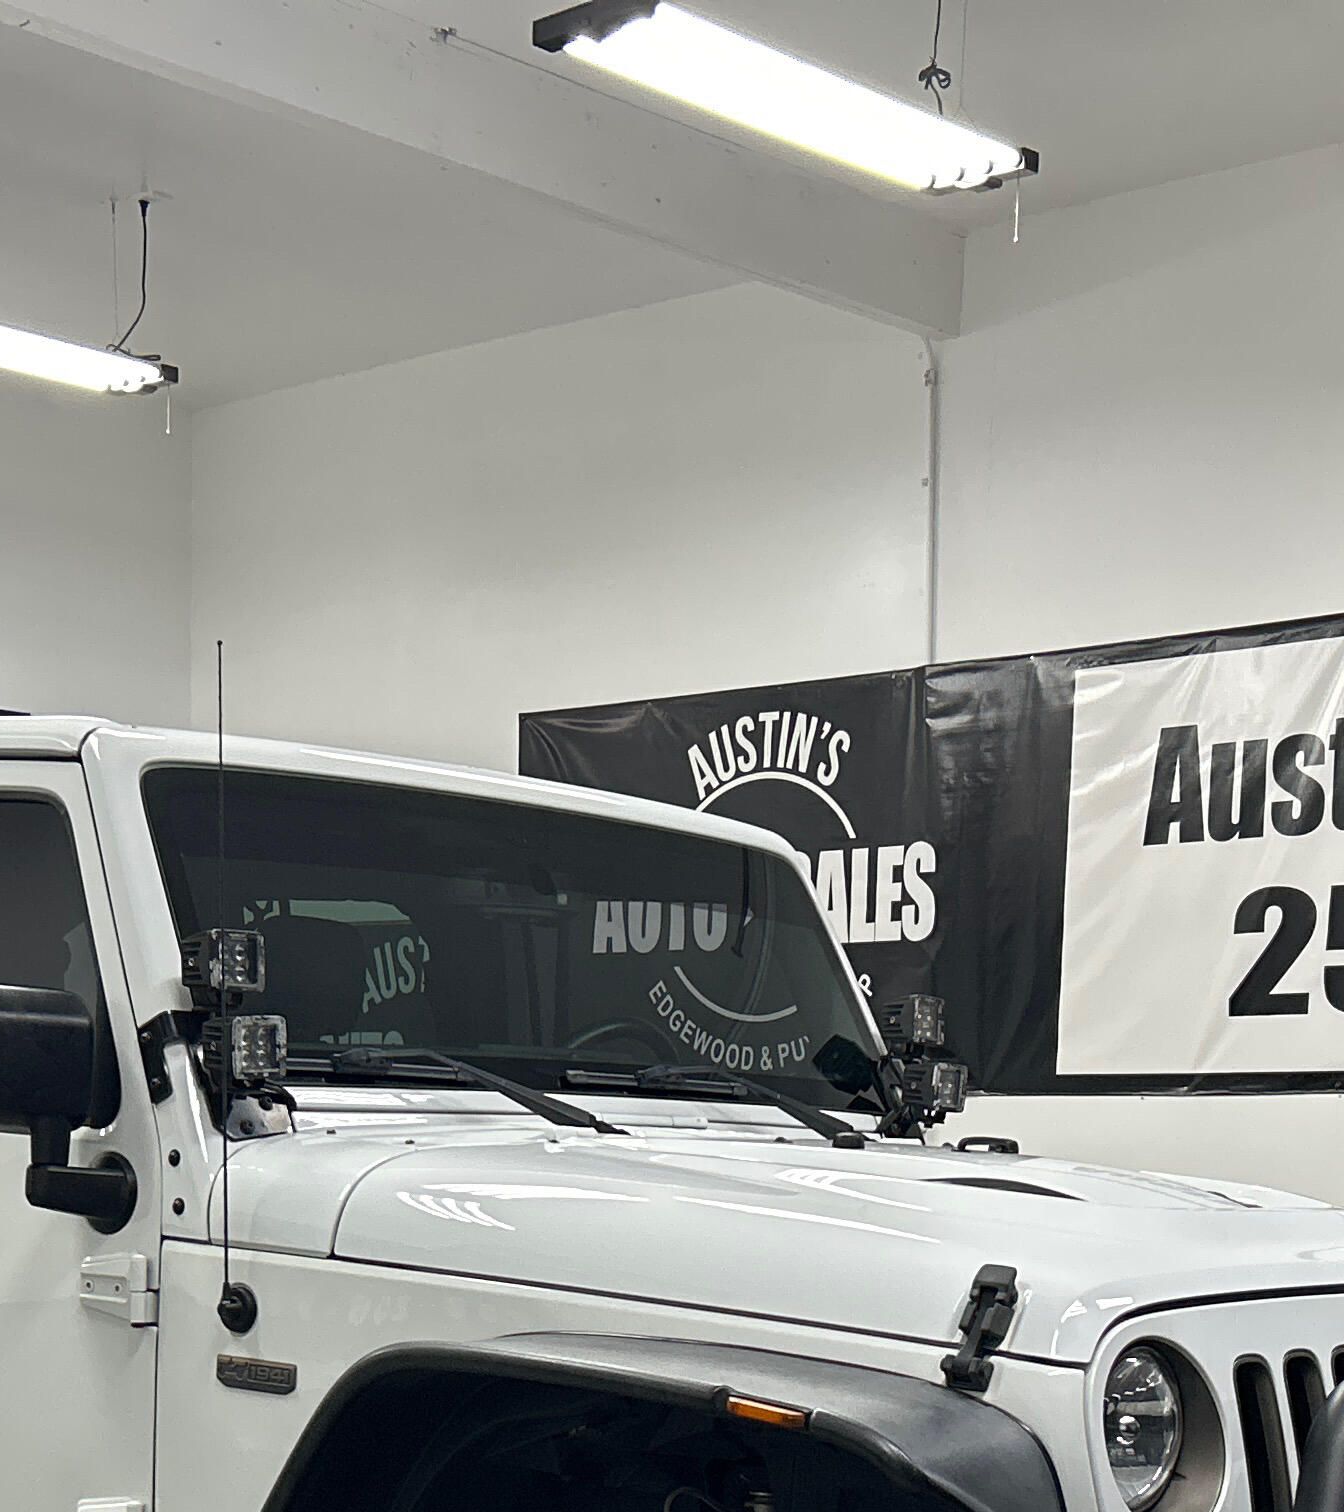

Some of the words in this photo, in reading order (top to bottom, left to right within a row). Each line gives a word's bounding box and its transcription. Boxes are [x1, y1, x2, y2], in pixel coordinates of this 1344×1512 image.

[687, 711, 851, 801] AUSTIN'S
[795, 840, 936, 943] ALES
[649, 980, 755, 1071] EDGEWOOD
[760, 1045, 774, 1071] &
[249, 1366, 291, 1384] 1941
